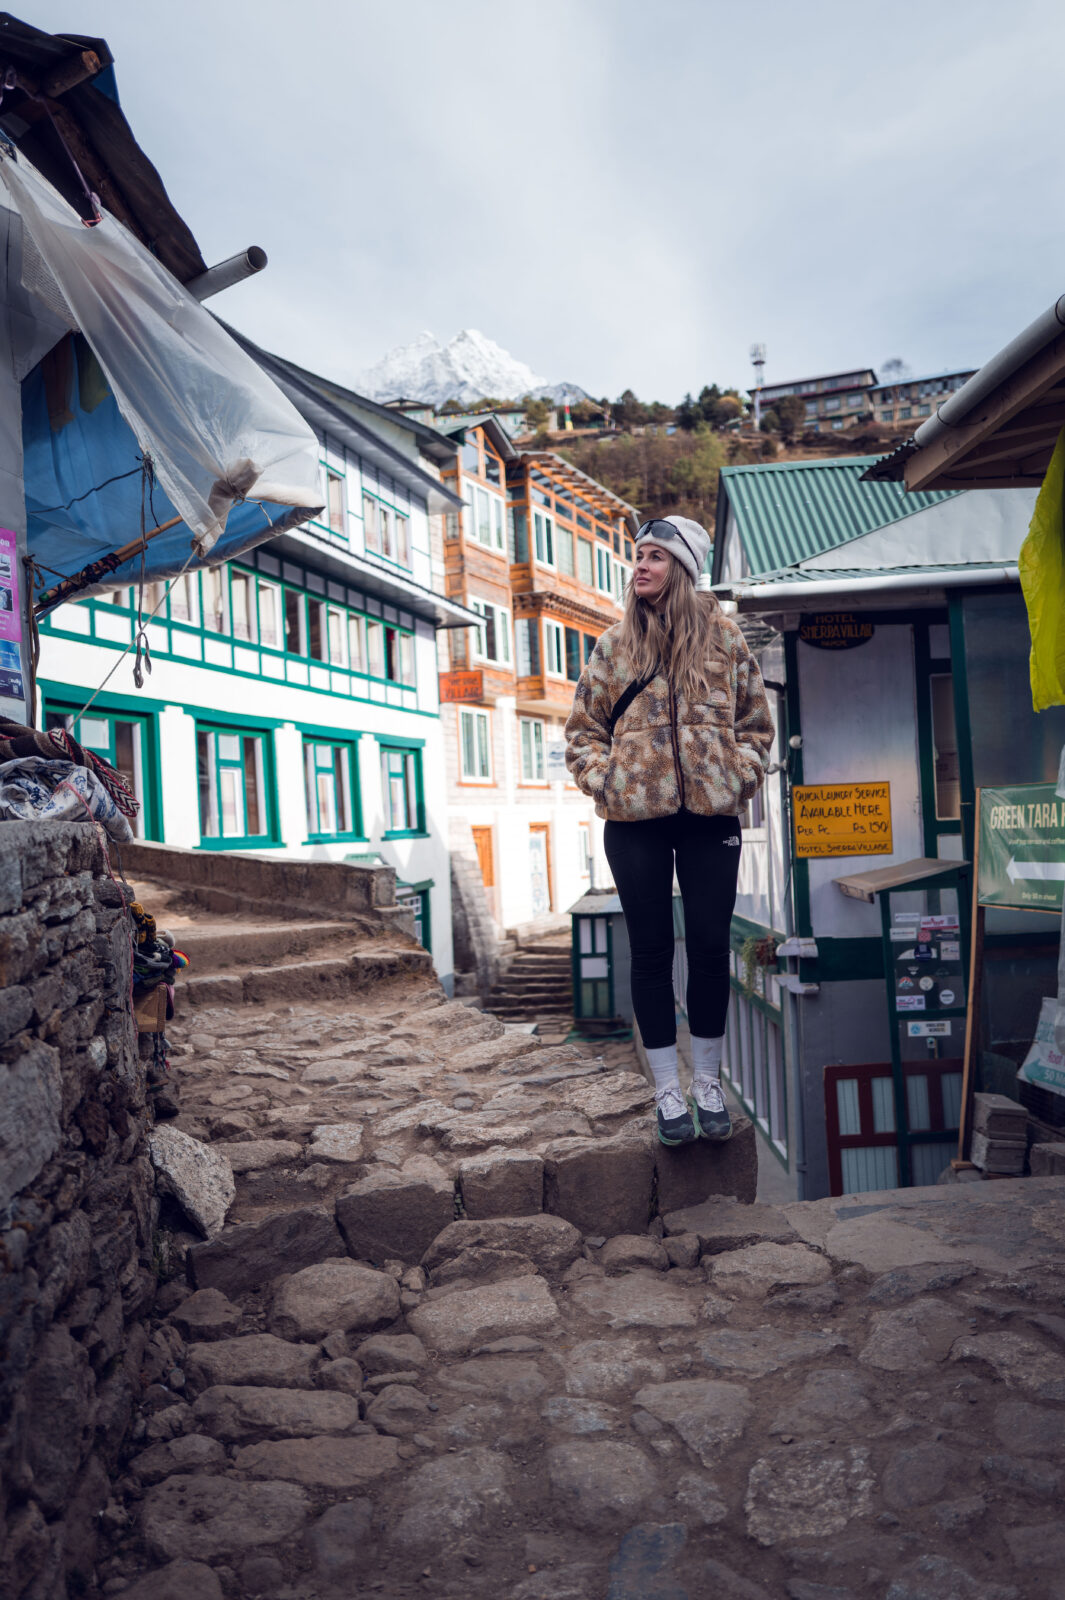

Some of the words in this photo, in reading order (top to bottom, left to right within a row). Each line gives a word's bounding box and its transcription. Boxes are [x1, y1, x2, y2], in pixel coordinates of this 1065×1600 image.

[815, 613, 857, 625] HOTEL
[795, 790, 820, 803] QUICK
[820, 789, 853, 801] LAUNDRY
[854, 787, 887, 799] SERVICE
[800, 804, 852, 819] AVAILABLE
[854, 803, 883, 817] HERE
[990, 804, 1025, 829] GREEN
[1027, 802, 1058, 828] TARA
[798, 844, 824, 853] HOTEL
